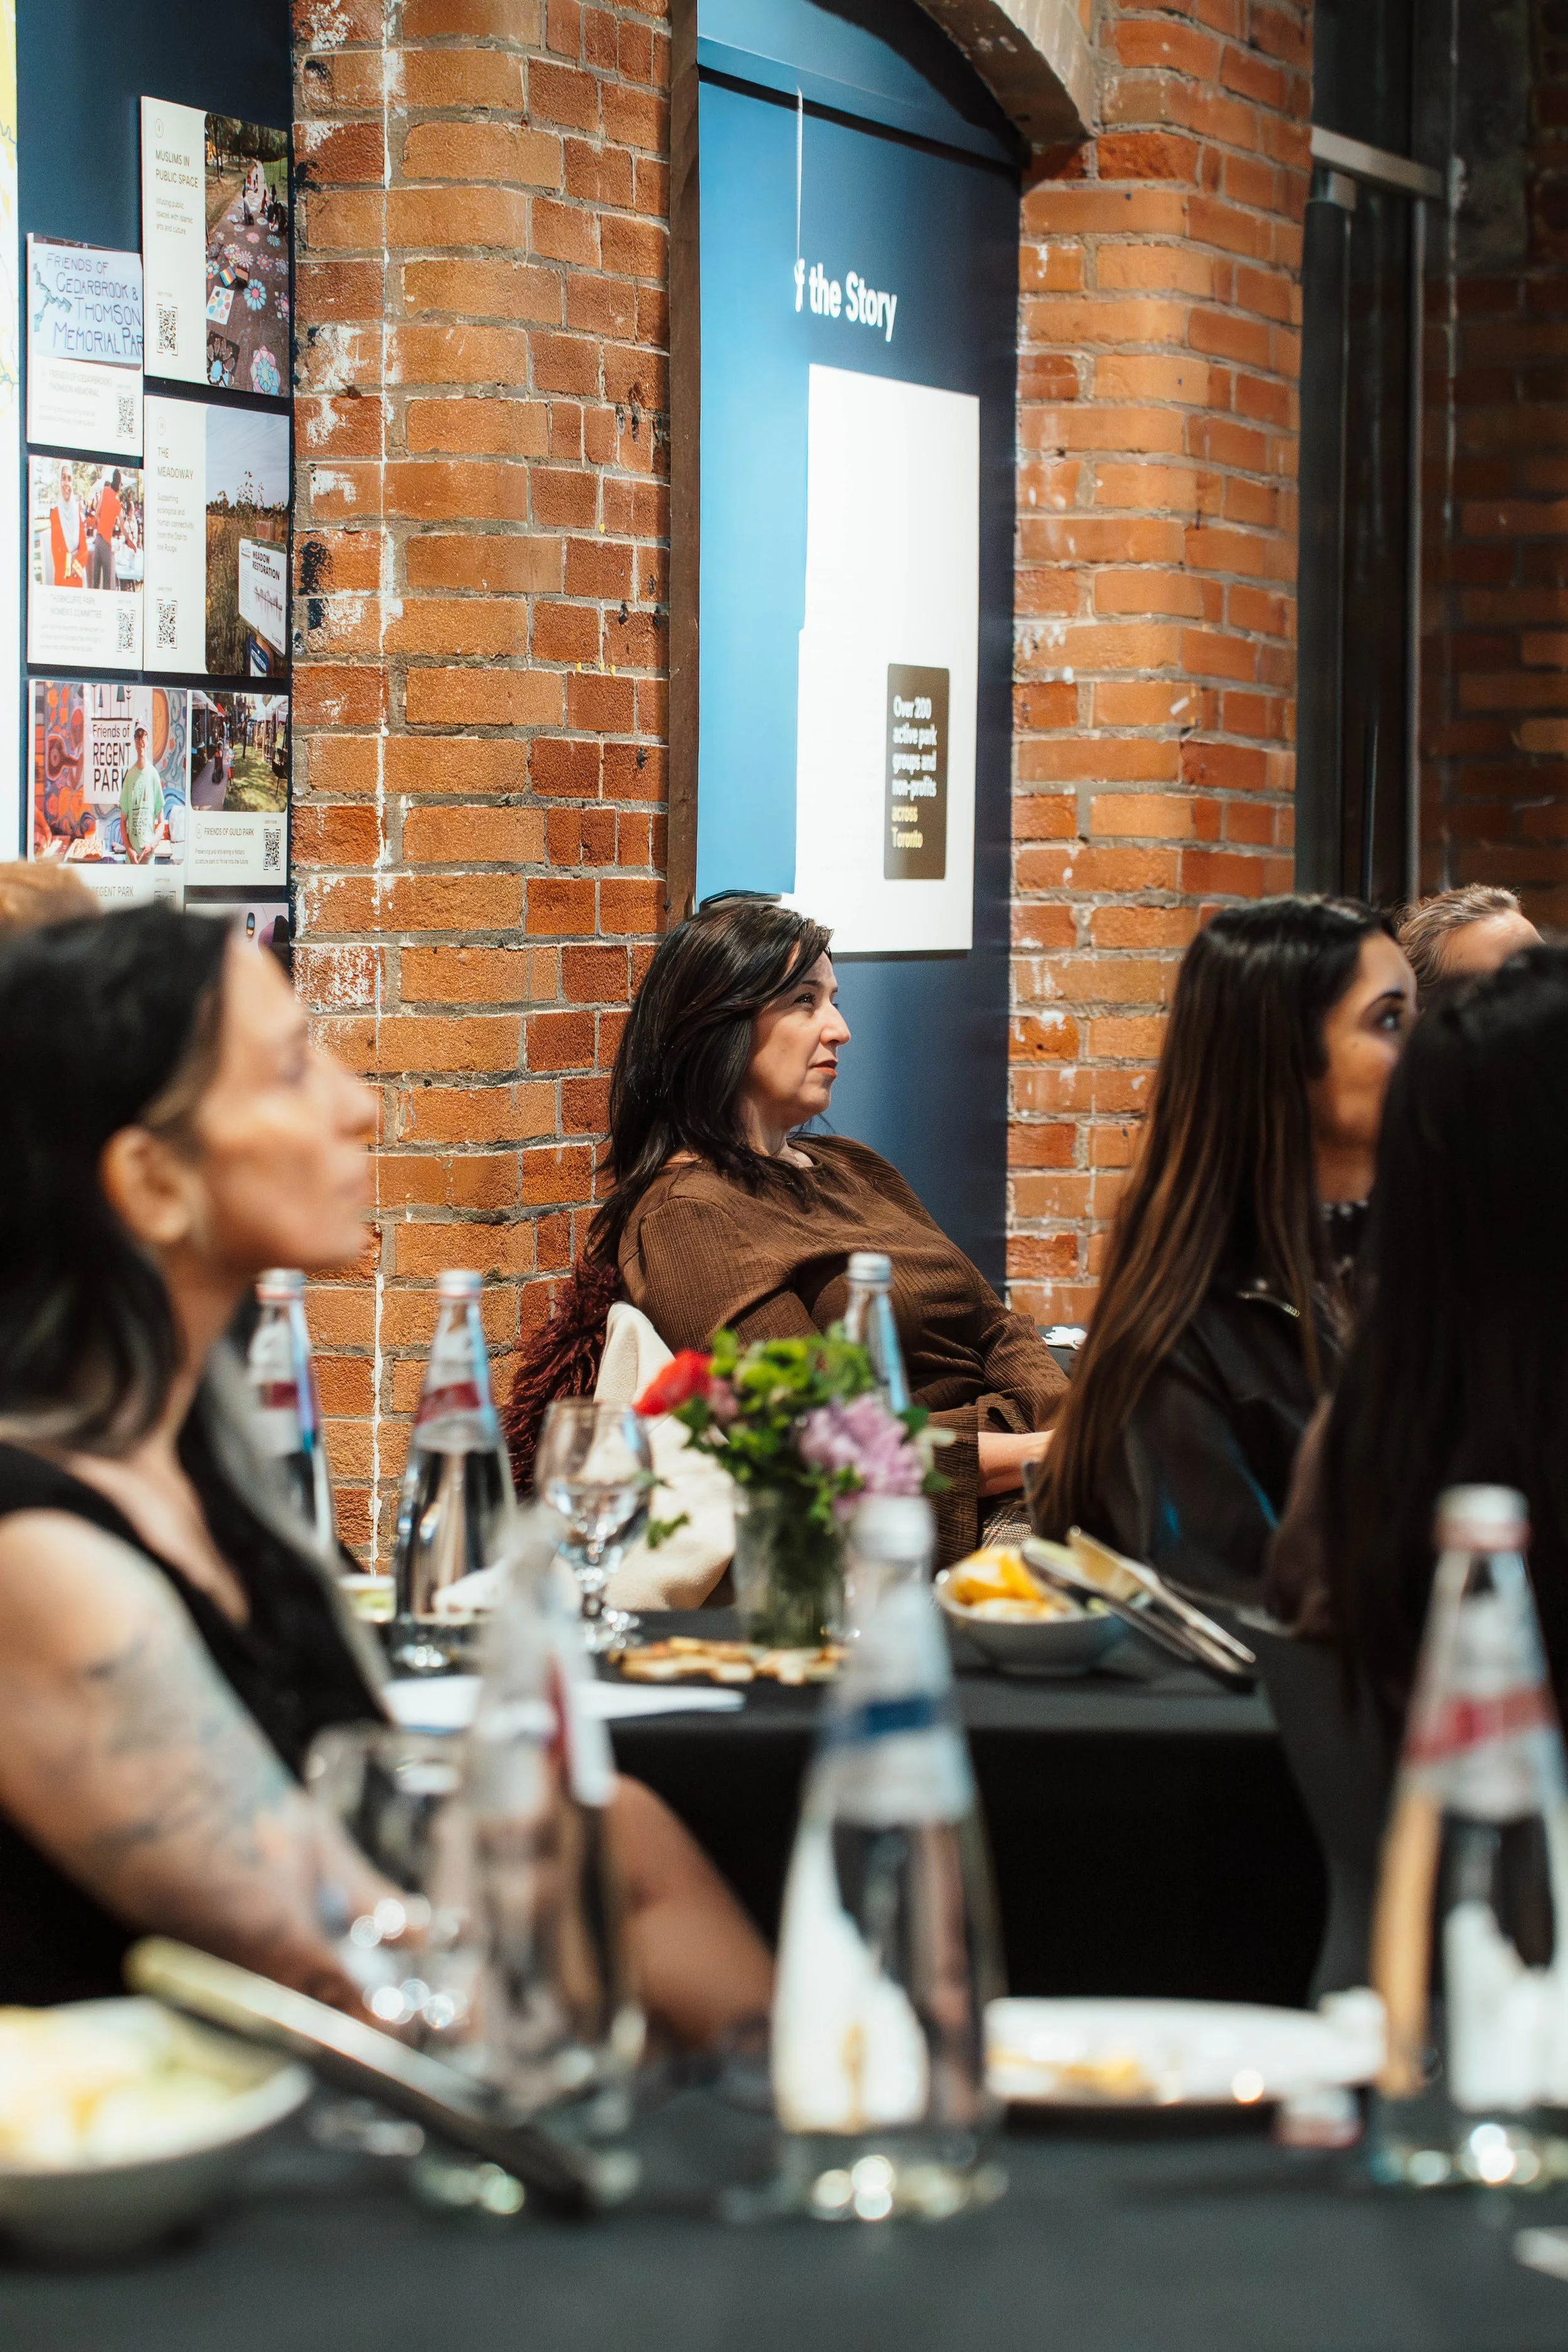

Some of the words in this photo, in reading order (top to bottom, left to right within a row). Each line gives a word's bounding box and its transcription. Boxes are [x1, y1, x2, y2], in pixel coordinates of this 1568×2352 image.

[156, 149, 182, 165] MUSLIMS
[184, 156, 190, 167] IN
[156, 168, 177, 183] PUBLIC
[178, 174, 199, 188] SPACE
[46, 253, 92, 272] FRIENDS
[97, 262, 109, 275] OF
[56, 272, 129, 299] CEDARBROOK
[132, 287, 139, 301] &
[794, 258, 805, 312] f
[809, 262, 842, 318] the
[845, 270, 898, 342] Story
[75, 297, 141, 326] THOMSON
[53, 321, 120, 354] MEMORIAL
[157, 447, 169, 458] THE
[157, 466, 193, 479] MEADOWAY
[253, 551, 270, 564] MEADOW
[253, 561, 280, 581] RESTORATION
[893, 695, 914, 718] Over
[914, 696, 932, 719] 200
[93, 724, 120, 738] Friends
[122, 724, 130, 738] of
[893, 721, 918, 744] active
[918, 723, 938, 750] park
[93, 742, 131, 766] REGENT
[892, 753, 920, 775] groups
[921, 749, 936, 771] and
[892, 775, 936, 802] non-profits
[891, 805, 918, 822] across
[204, 827, 221, 836] FRIENDS
[223, 828, 228, 836] OF
[230, 828, 241, 836] GUILD
[243, 828, 254, 836] PARK
[891, 825, 923, 849] Toronto
[117, 886, 134, 897] PARK
